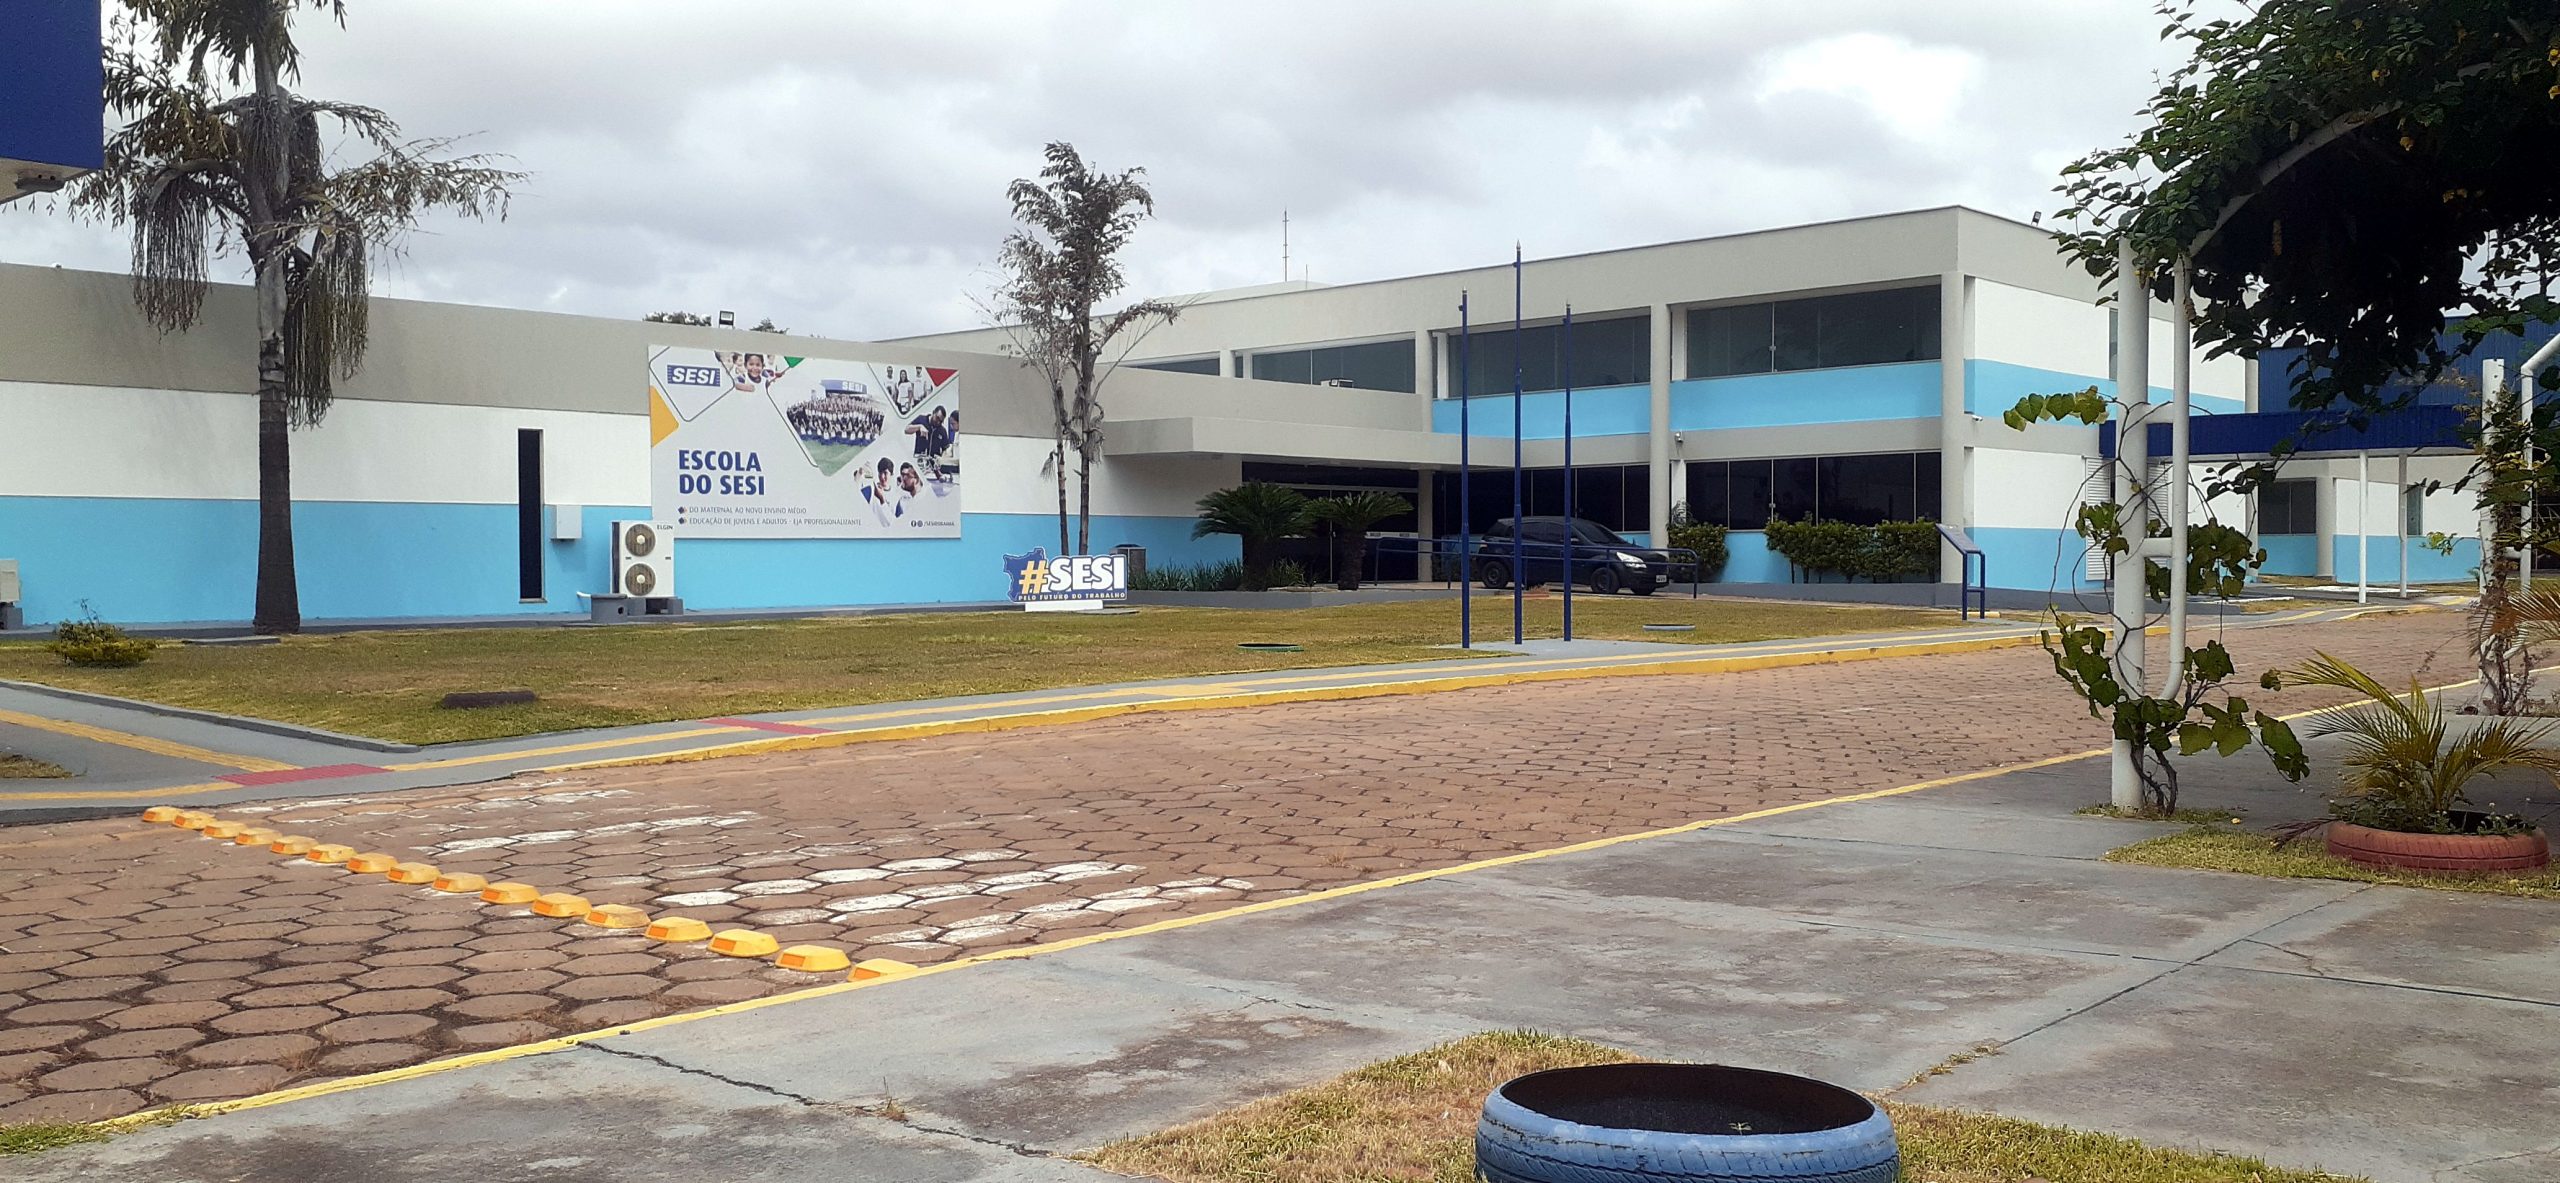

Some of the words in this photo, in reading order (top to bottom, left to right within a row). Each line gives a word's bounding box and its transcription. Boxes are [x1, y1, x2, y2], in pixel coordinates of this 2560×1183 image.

[671, 367, 716, 385] SESI
[679, 449, 762, 472] ESCOLA
[679, 473, 712, 495] DO
[720, 474, 765, 496] SESI
[735, 506, 744, 514] AO
[745, 506, 763, 514] NOVO
[689, 516, 723, 526] EDUCAÇÃO
[724, 517, 732, 525] DE
[733, 517, 755, 526] JOVENS
[1018, 557, 1126, 595] #SESI
